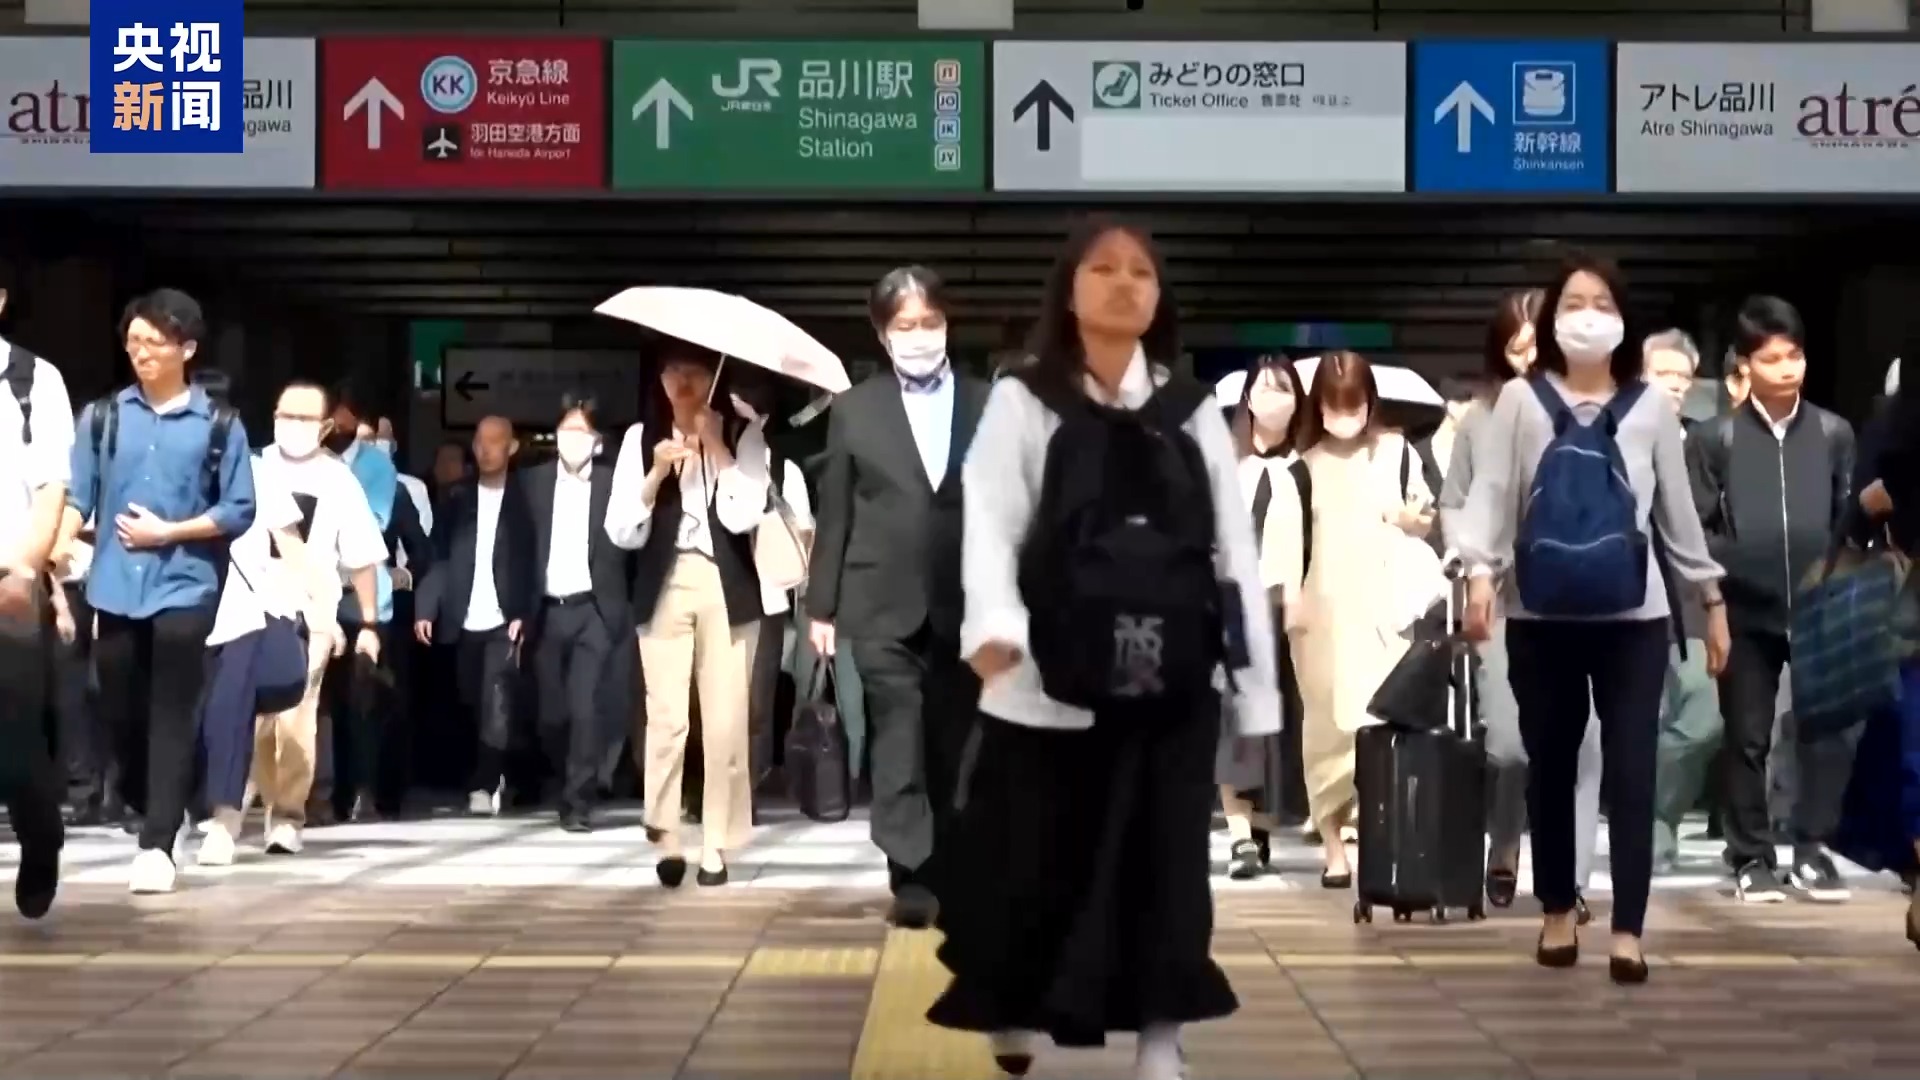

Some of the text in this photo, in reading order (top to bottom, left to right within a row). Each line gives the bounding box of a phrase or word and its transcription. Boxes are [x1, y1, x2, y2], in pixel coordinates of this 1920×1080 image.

[488, 59, 569, 85] 京急線
[712, 58, 782, 97] JR
[798, 59, 913, 100] 品川駅
[1149, 61, 1305, 88] みどりの窓口
[433, 75, 464, 94] KK
[8, 79, 90, 133] atr
[540, 91, 570, 105] Line
[1150, 92, 1249, 108] Ticket Office
[1640, 82, 1775, 112] アトレ品川
[799, 107, 918, 134] Shinagawa
[1641, 119, 1774, 139] Atre Shinagawa
[471, 123, 580, 144] 羽田空港方面
[1514, 132, 1581, 153] 新幹線
[488, 147, 531, 158] Haneda
[534, 147, 571, 160] Airport
[799, 136, 873, 158] Station
